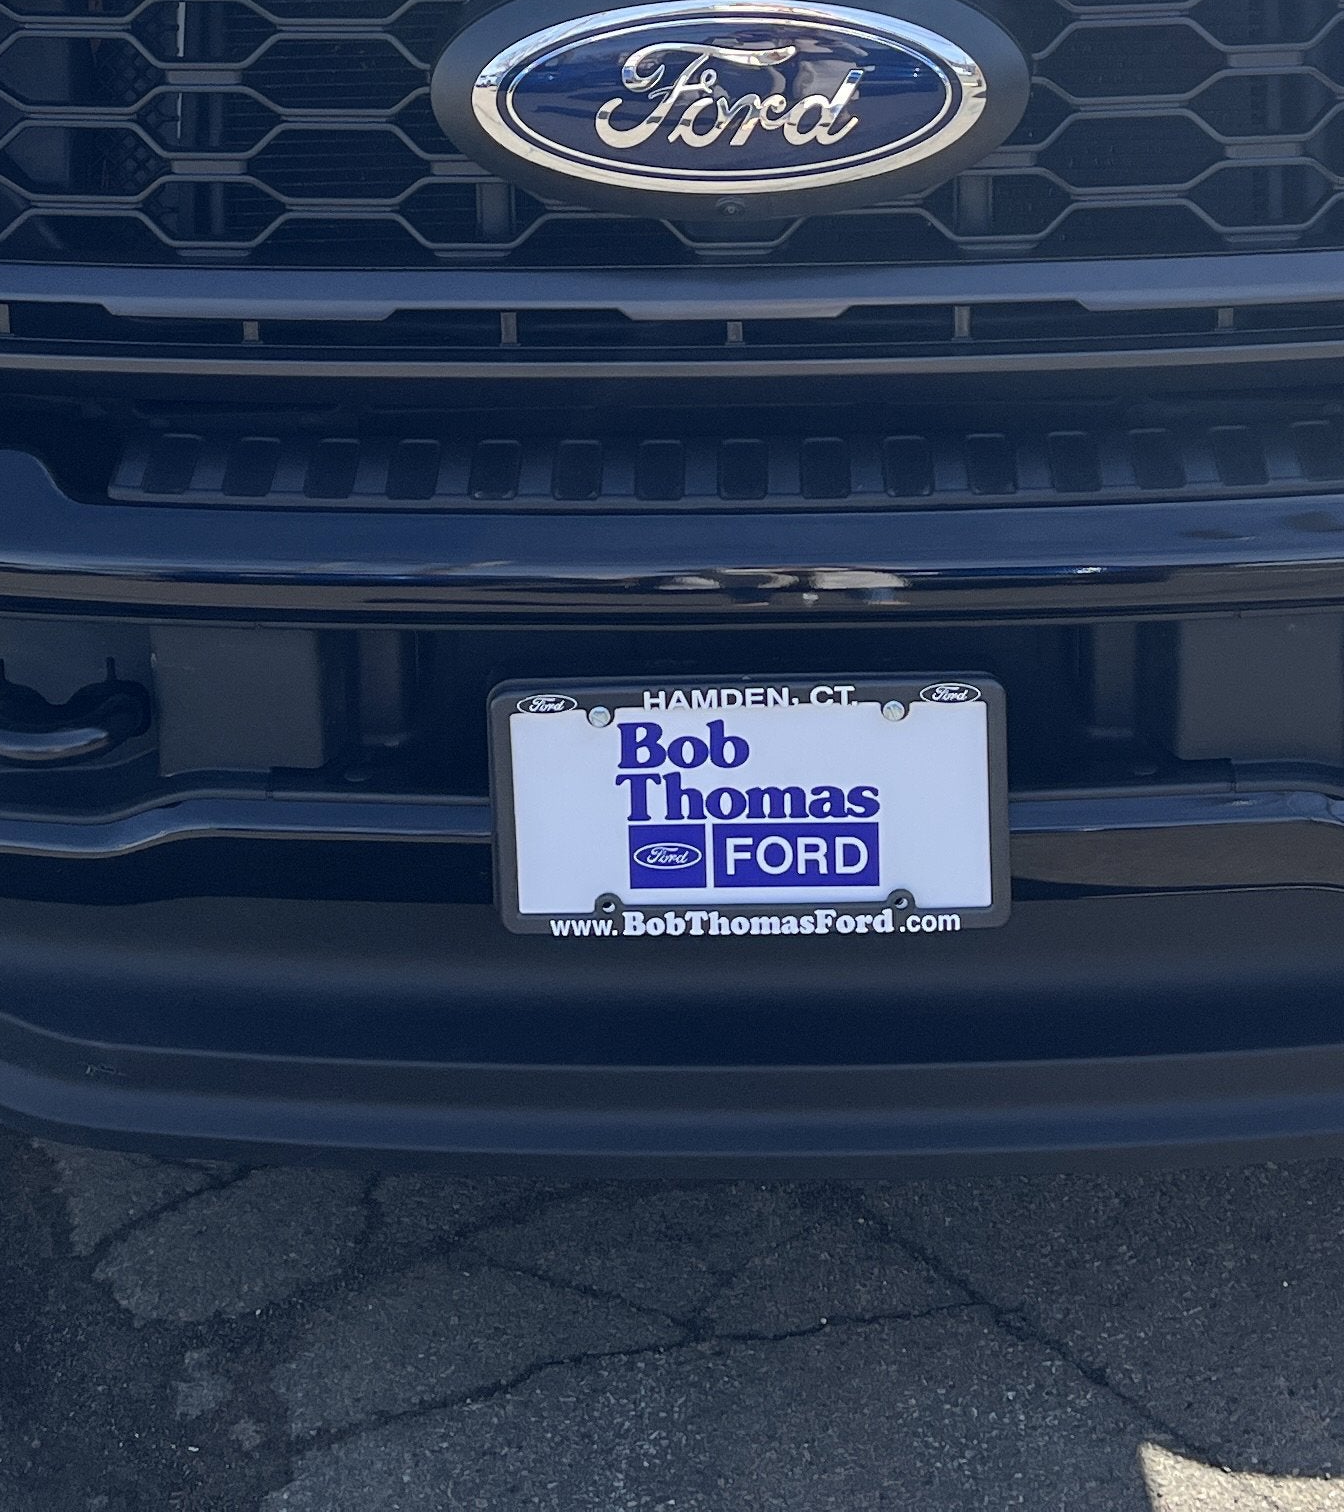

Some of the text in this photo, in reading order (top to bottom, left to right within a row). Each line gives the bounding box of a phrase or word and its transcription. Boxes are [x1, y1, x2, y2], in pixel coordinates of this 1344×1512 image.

[594, 41, 864, 148] Ford
[528, 696, 565, 714] Ford
[931, 685, 968, 703] Ford
[617, 719, 750, 769] Bob
[615, 772, 880, 821] Thomas
[646, 836, 869, 875] Ford FORD
[550, 910, 961, 937] www.BobThomasFord.com
